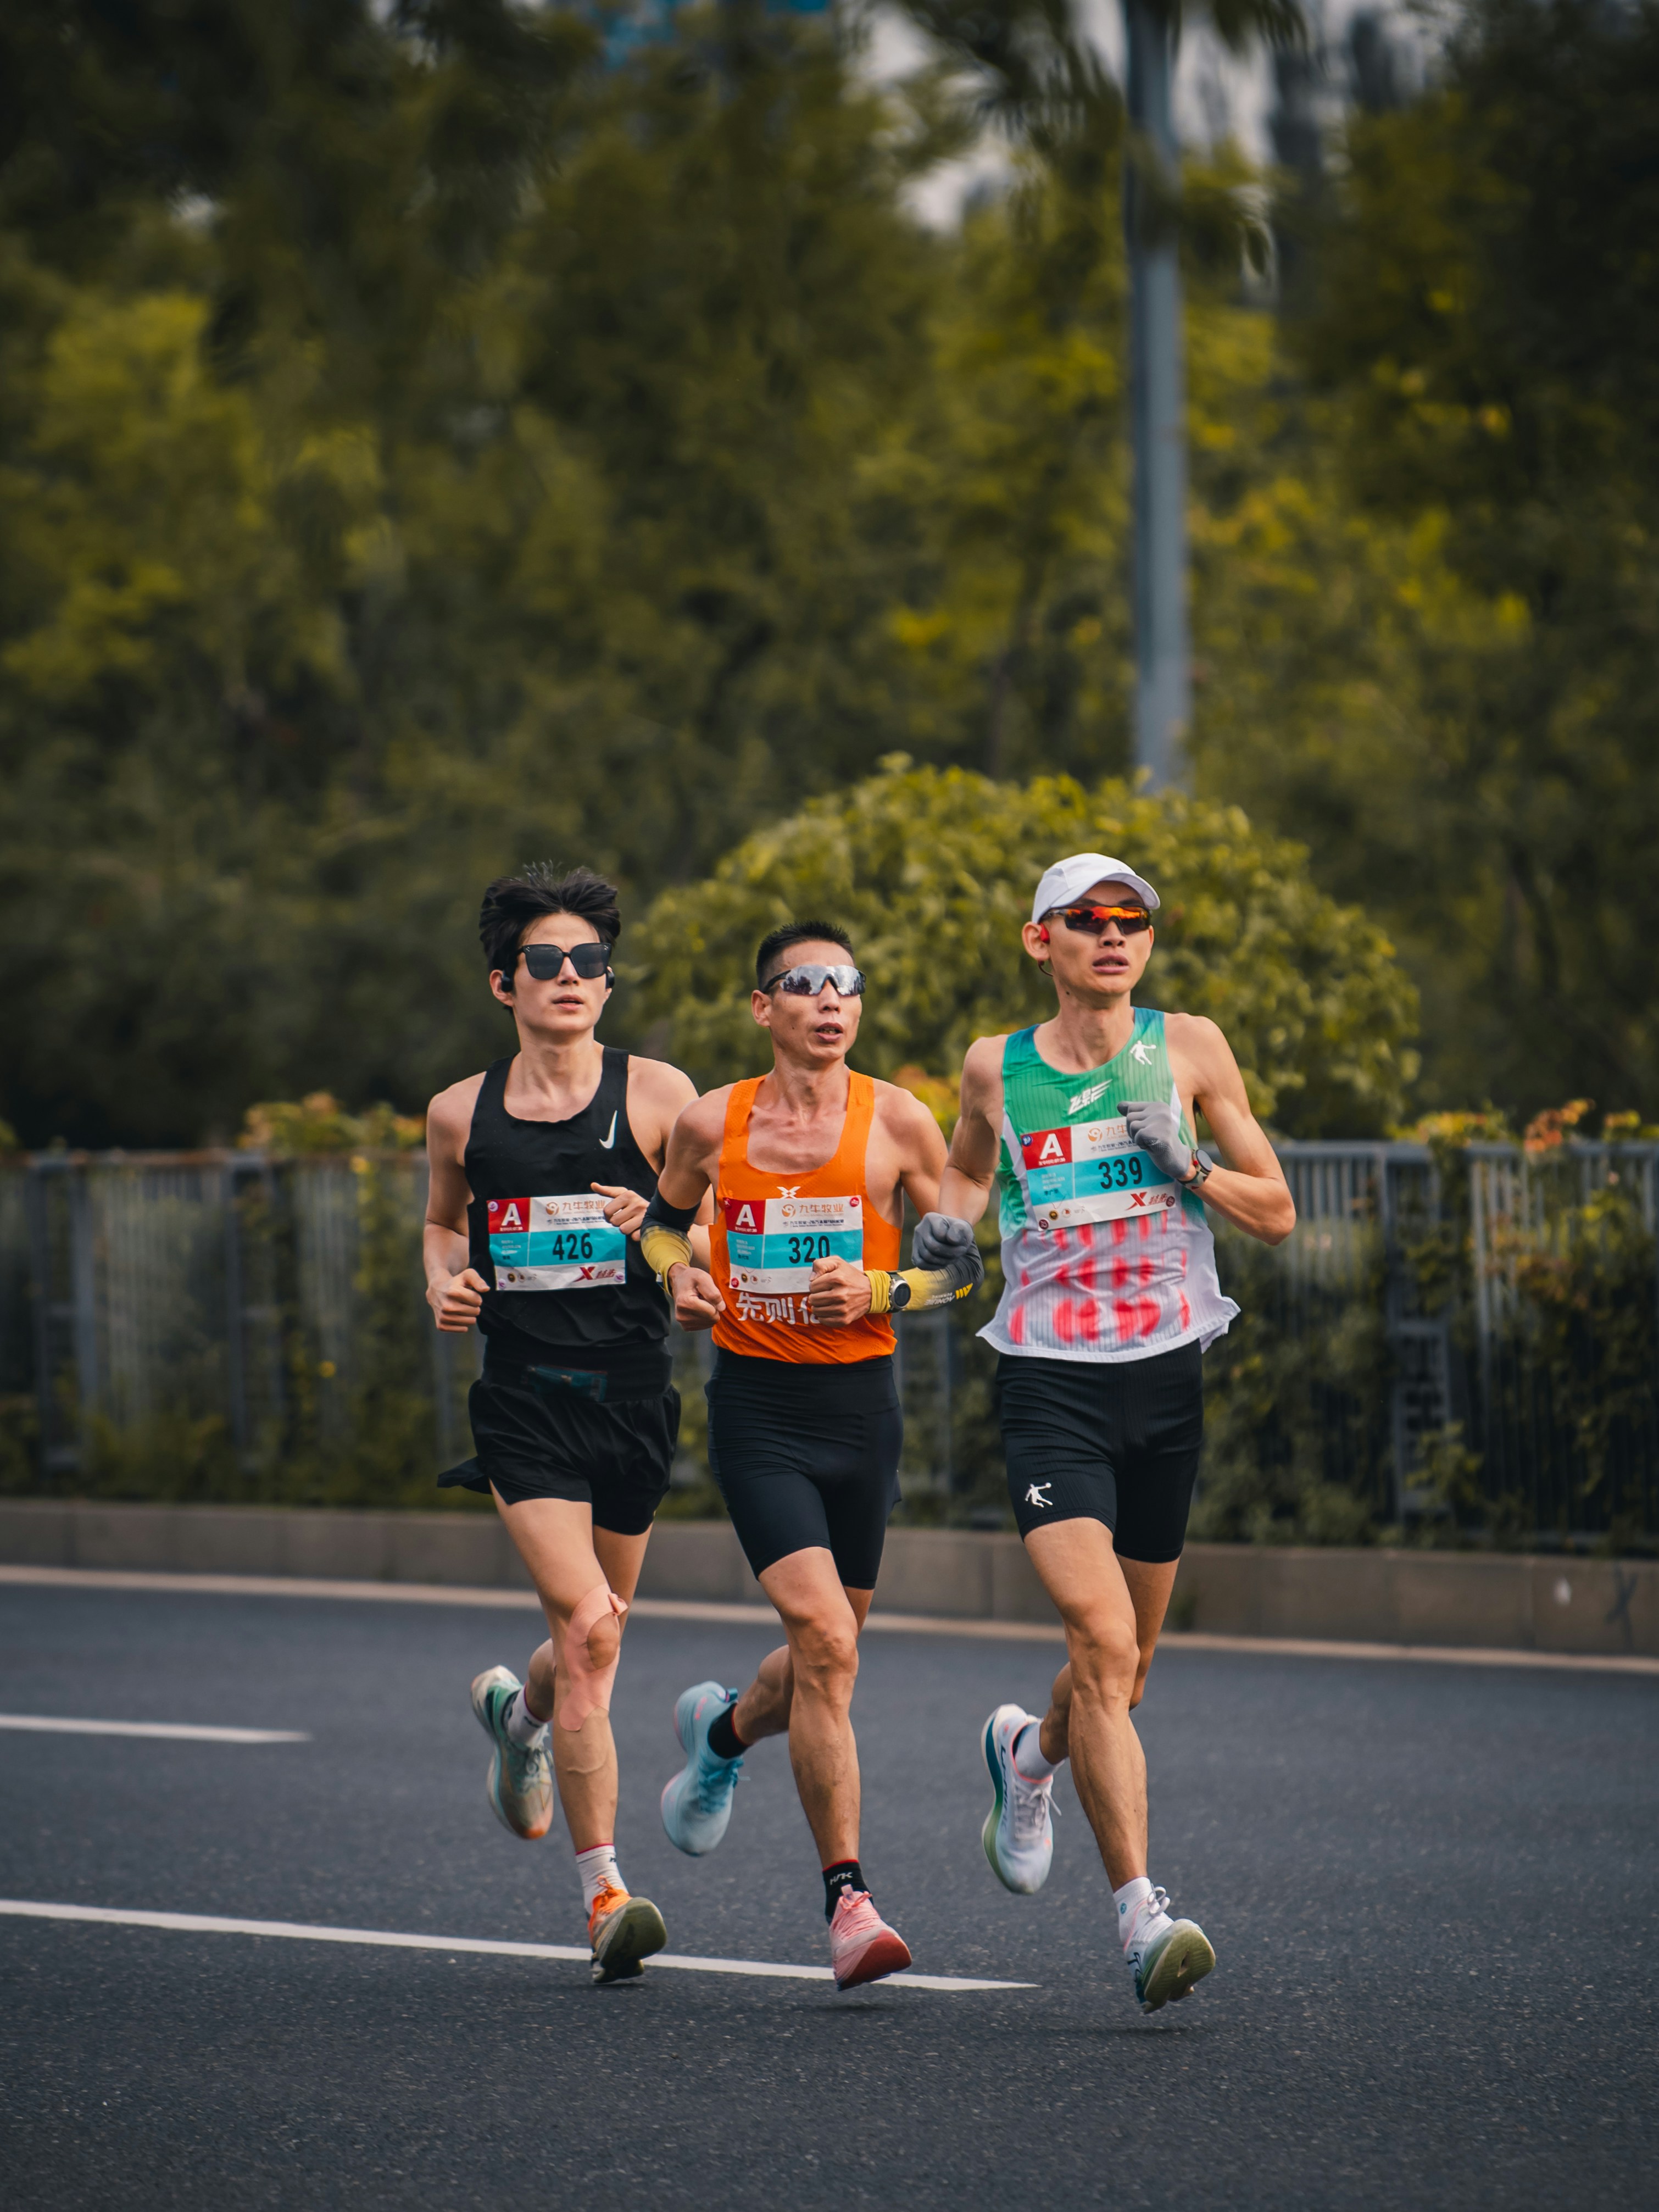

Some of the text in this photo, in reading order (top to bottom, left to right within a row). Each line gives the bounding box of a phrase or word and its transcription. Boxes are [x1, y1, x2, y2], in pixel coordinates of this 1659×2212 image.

[1106, 1124, 1127, 1136] 九牛
[1039, 1133, 1064, 1160] A
[1098, 1156, 1143, 1190] 339
[501, 1203, 522, 1226] A
[562, 1200, 605, 1211] 九牛牧业
[736, 1204, 756, 1227] A
[799, 1203, 844, 1213] 九牛牧业
[552, 1232, 593, 1260] 426
[788, 1235, 830, 1264] 320
